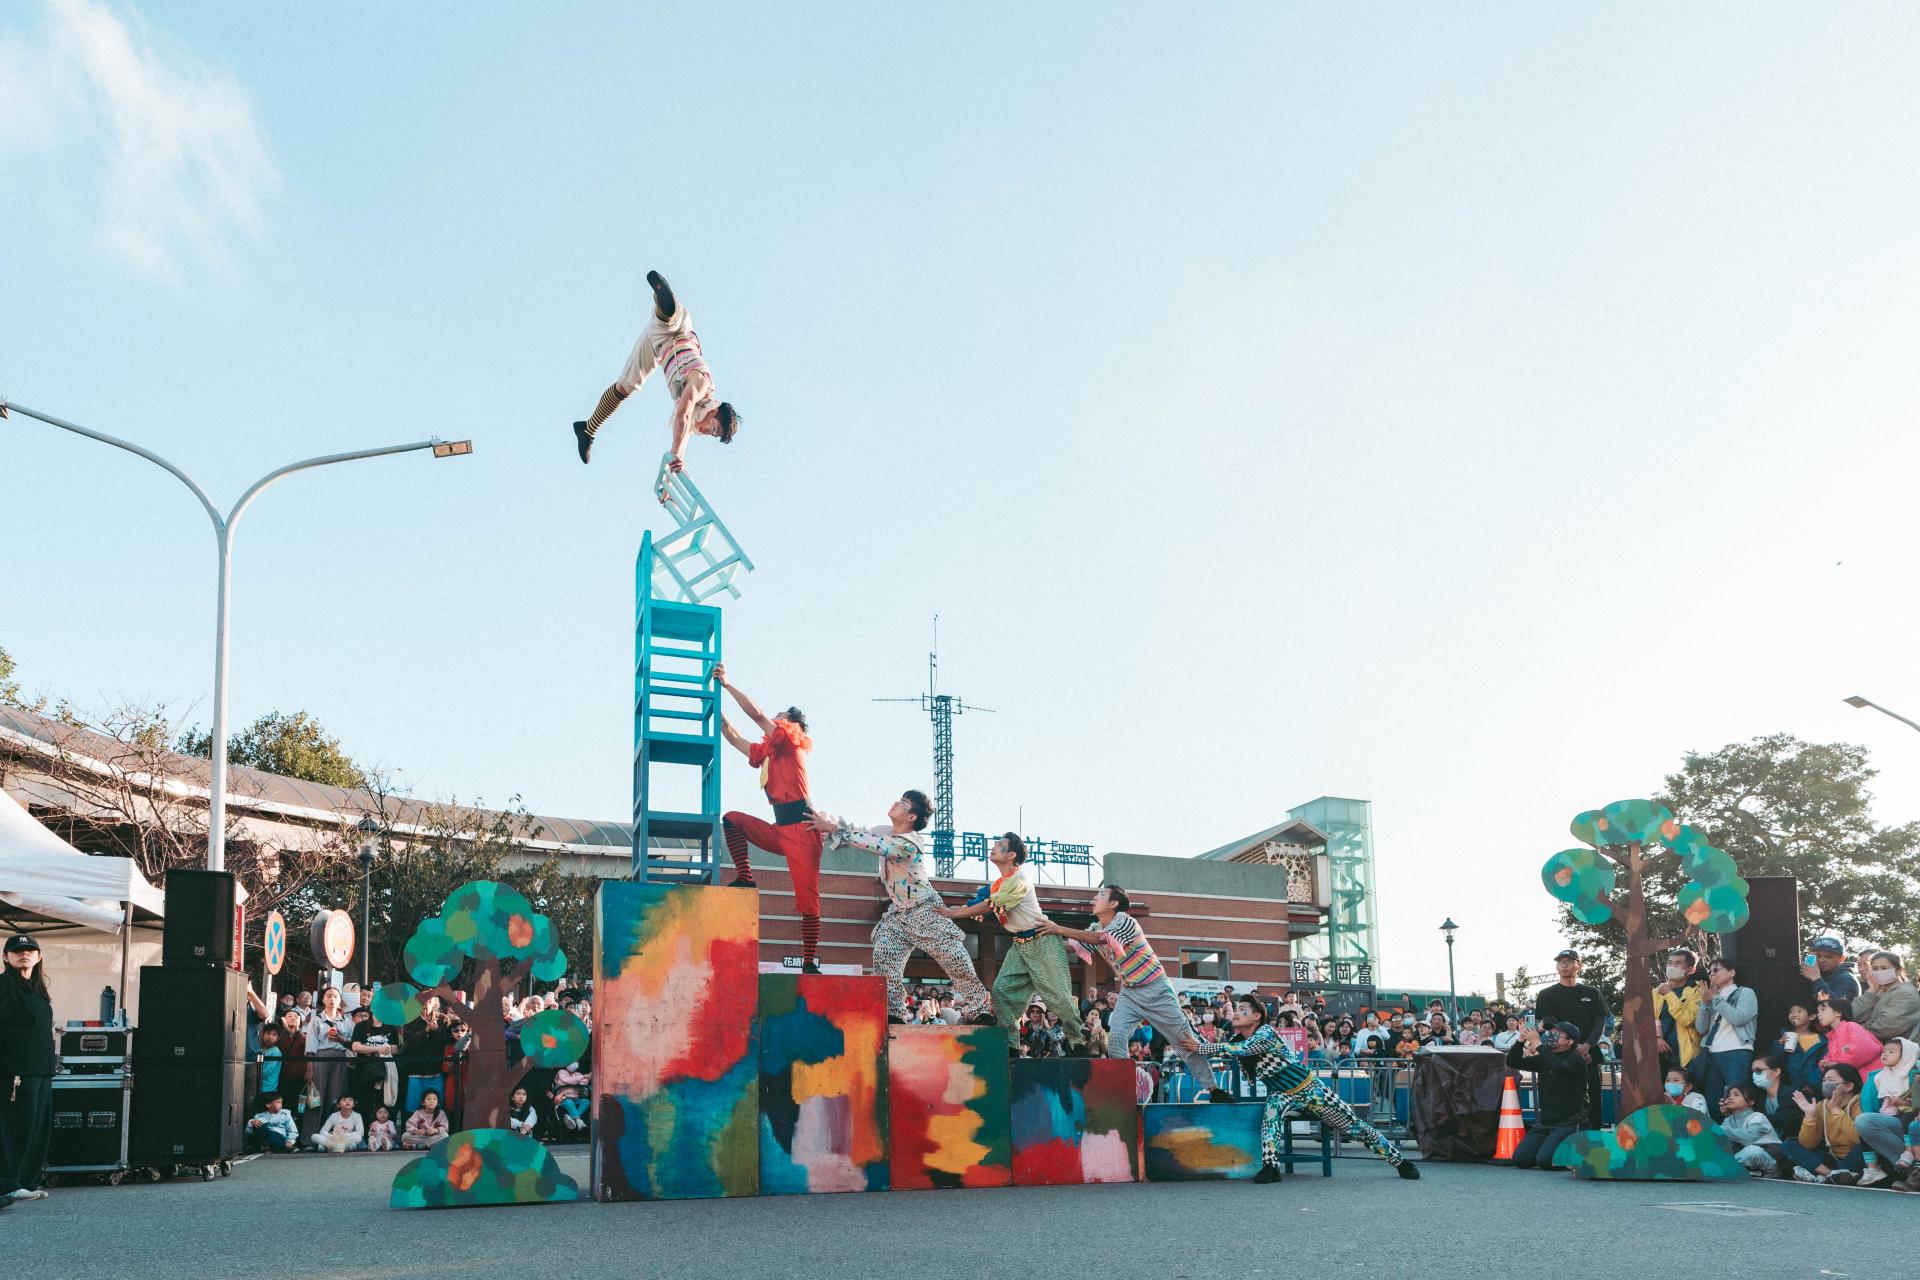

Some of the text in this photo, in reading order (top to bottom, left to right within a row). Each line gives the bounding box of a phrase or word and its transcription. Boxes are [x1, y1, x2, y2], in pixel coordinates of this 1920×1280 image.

[931, 831, 1046, 866] 富岡站
[1052, 841, 1089, 854] Fugang
[1052, 852, 1090, 865] Station
